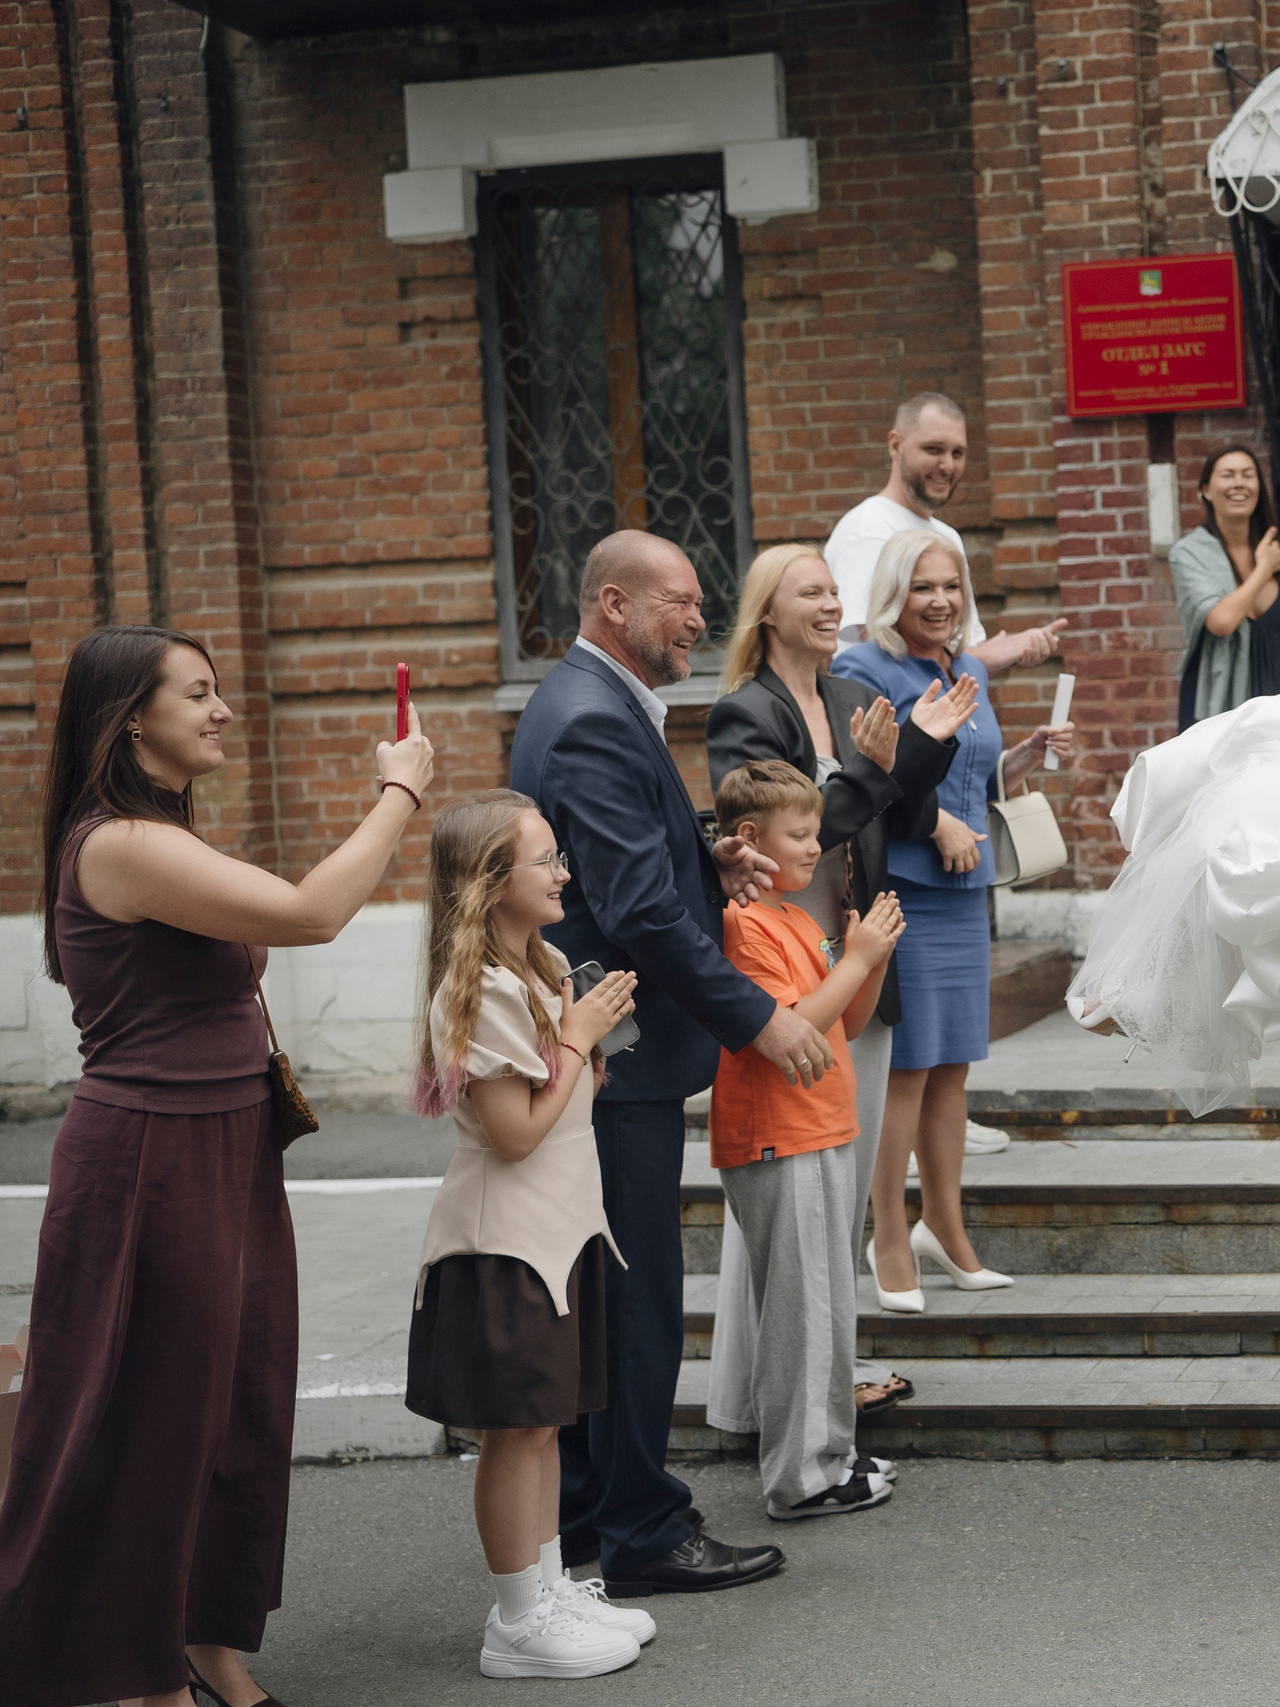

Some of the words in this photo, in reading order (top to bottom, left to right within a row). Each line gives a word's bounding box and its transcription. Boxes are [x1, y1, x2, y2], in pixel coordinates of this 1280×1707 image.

[1101, 344, 1159, 362] ОТДЕЛ
[1162, 341, 1206, 358] ЗАГС
[1138, 364, 1156, 377] №
[1159, 360, 1169, 375] 1
